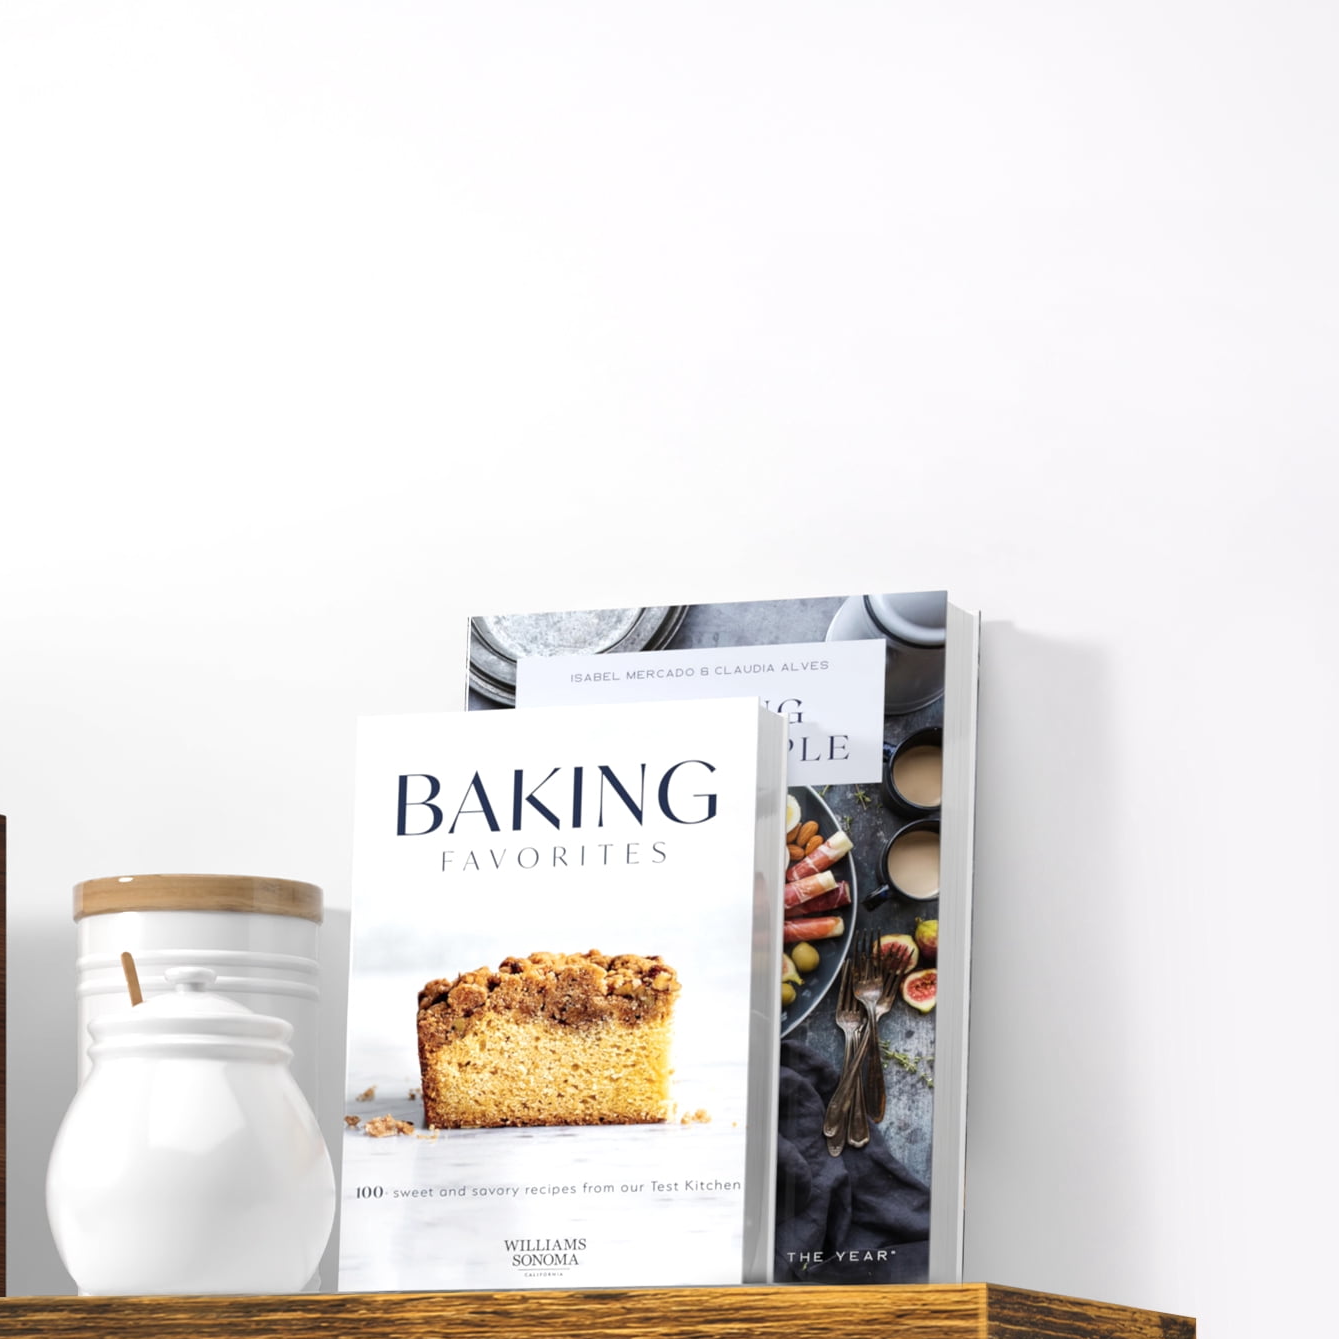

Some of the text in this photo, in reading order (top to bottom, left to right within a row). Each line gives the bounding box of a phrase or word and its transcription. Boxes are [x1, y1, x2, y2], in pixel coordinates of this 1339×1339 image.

[570, 671, 621, 683] ISABEL
[626, 667, 695, 680] MERCADO
[714, 663, 775, 676] CLAUDIA
[781, 660, 830, 672] ALVES
[396, 760, 718, 837] BAKING
[441, 841, 667, 872] FAVORITES
[393, 1187, 434, 1199] sweet
[439, 1185, 466, 1198] and
[473, 1184, 520, 1198] savory
[525, 1181, 577, 1197] recipes
[583, 1182, 615, 1194] from
[620, 1183, 644, 1193] our
[651, 1180, 680, 1193] Test
[684, 1178, 742, 1192] Kitchen
[504, 1238, 587, 1252] WILLIAMS
[512, 1253, 579, 1267] SONOMA
[787, 1251, 824, 1263] THE
